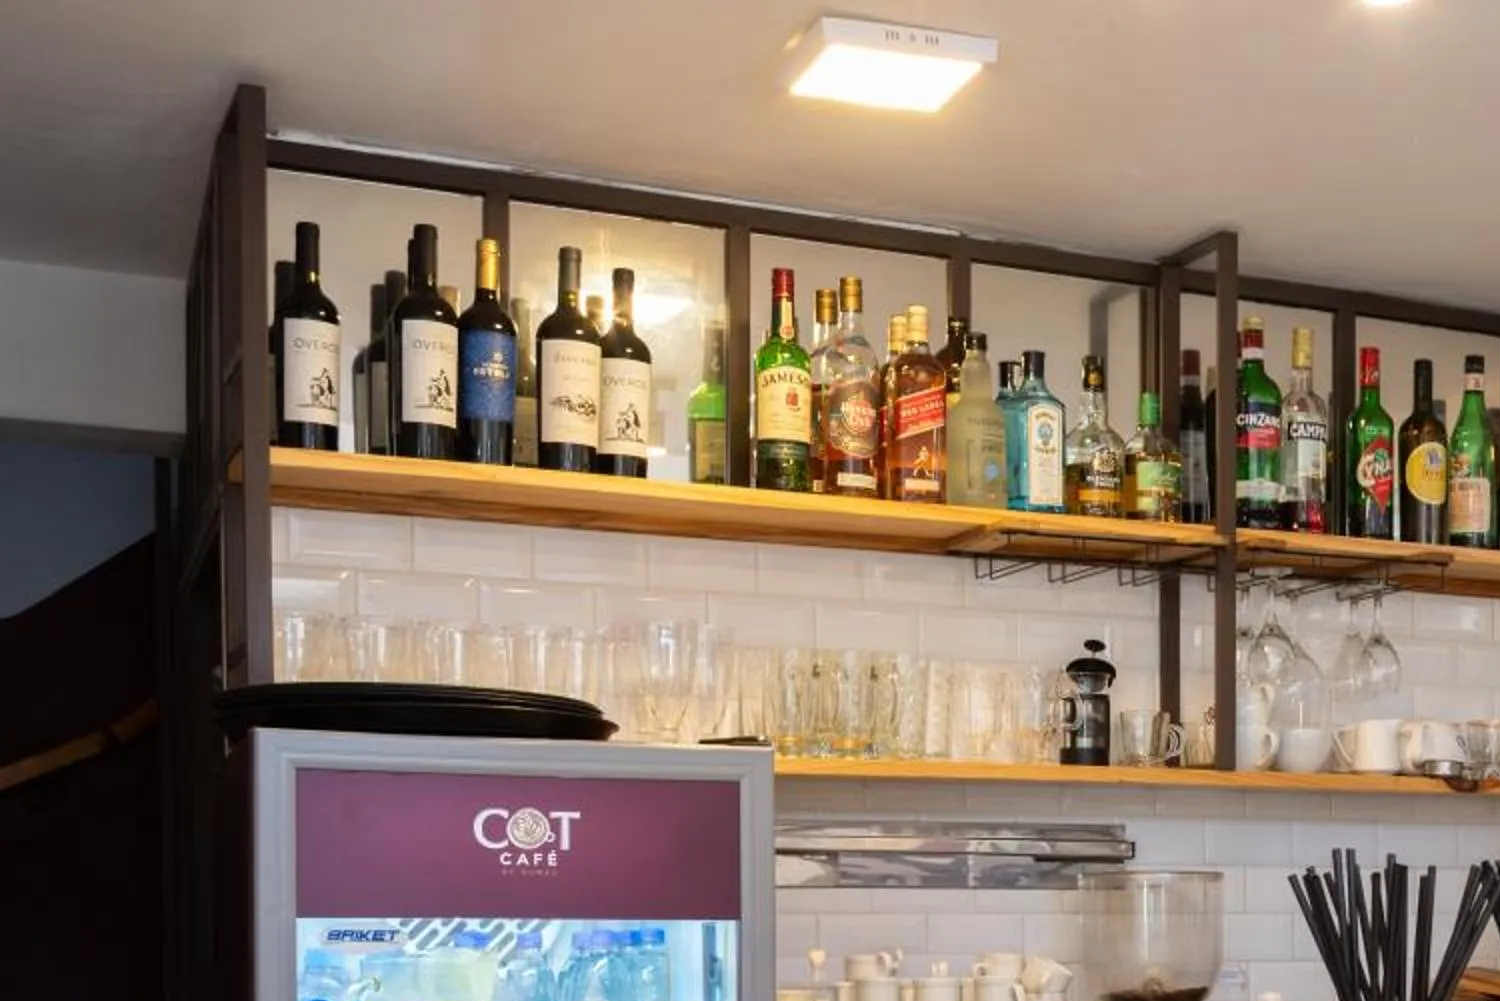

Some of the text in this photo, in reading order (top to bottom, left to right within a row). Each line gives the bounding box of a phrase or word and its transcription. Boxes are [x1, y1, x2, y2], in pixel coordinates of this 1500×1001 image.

[473, 807, 581, 851] COT
[499, 850, 558, 866] CAFÉ
[327, 928, 400, 942] BRIKET
